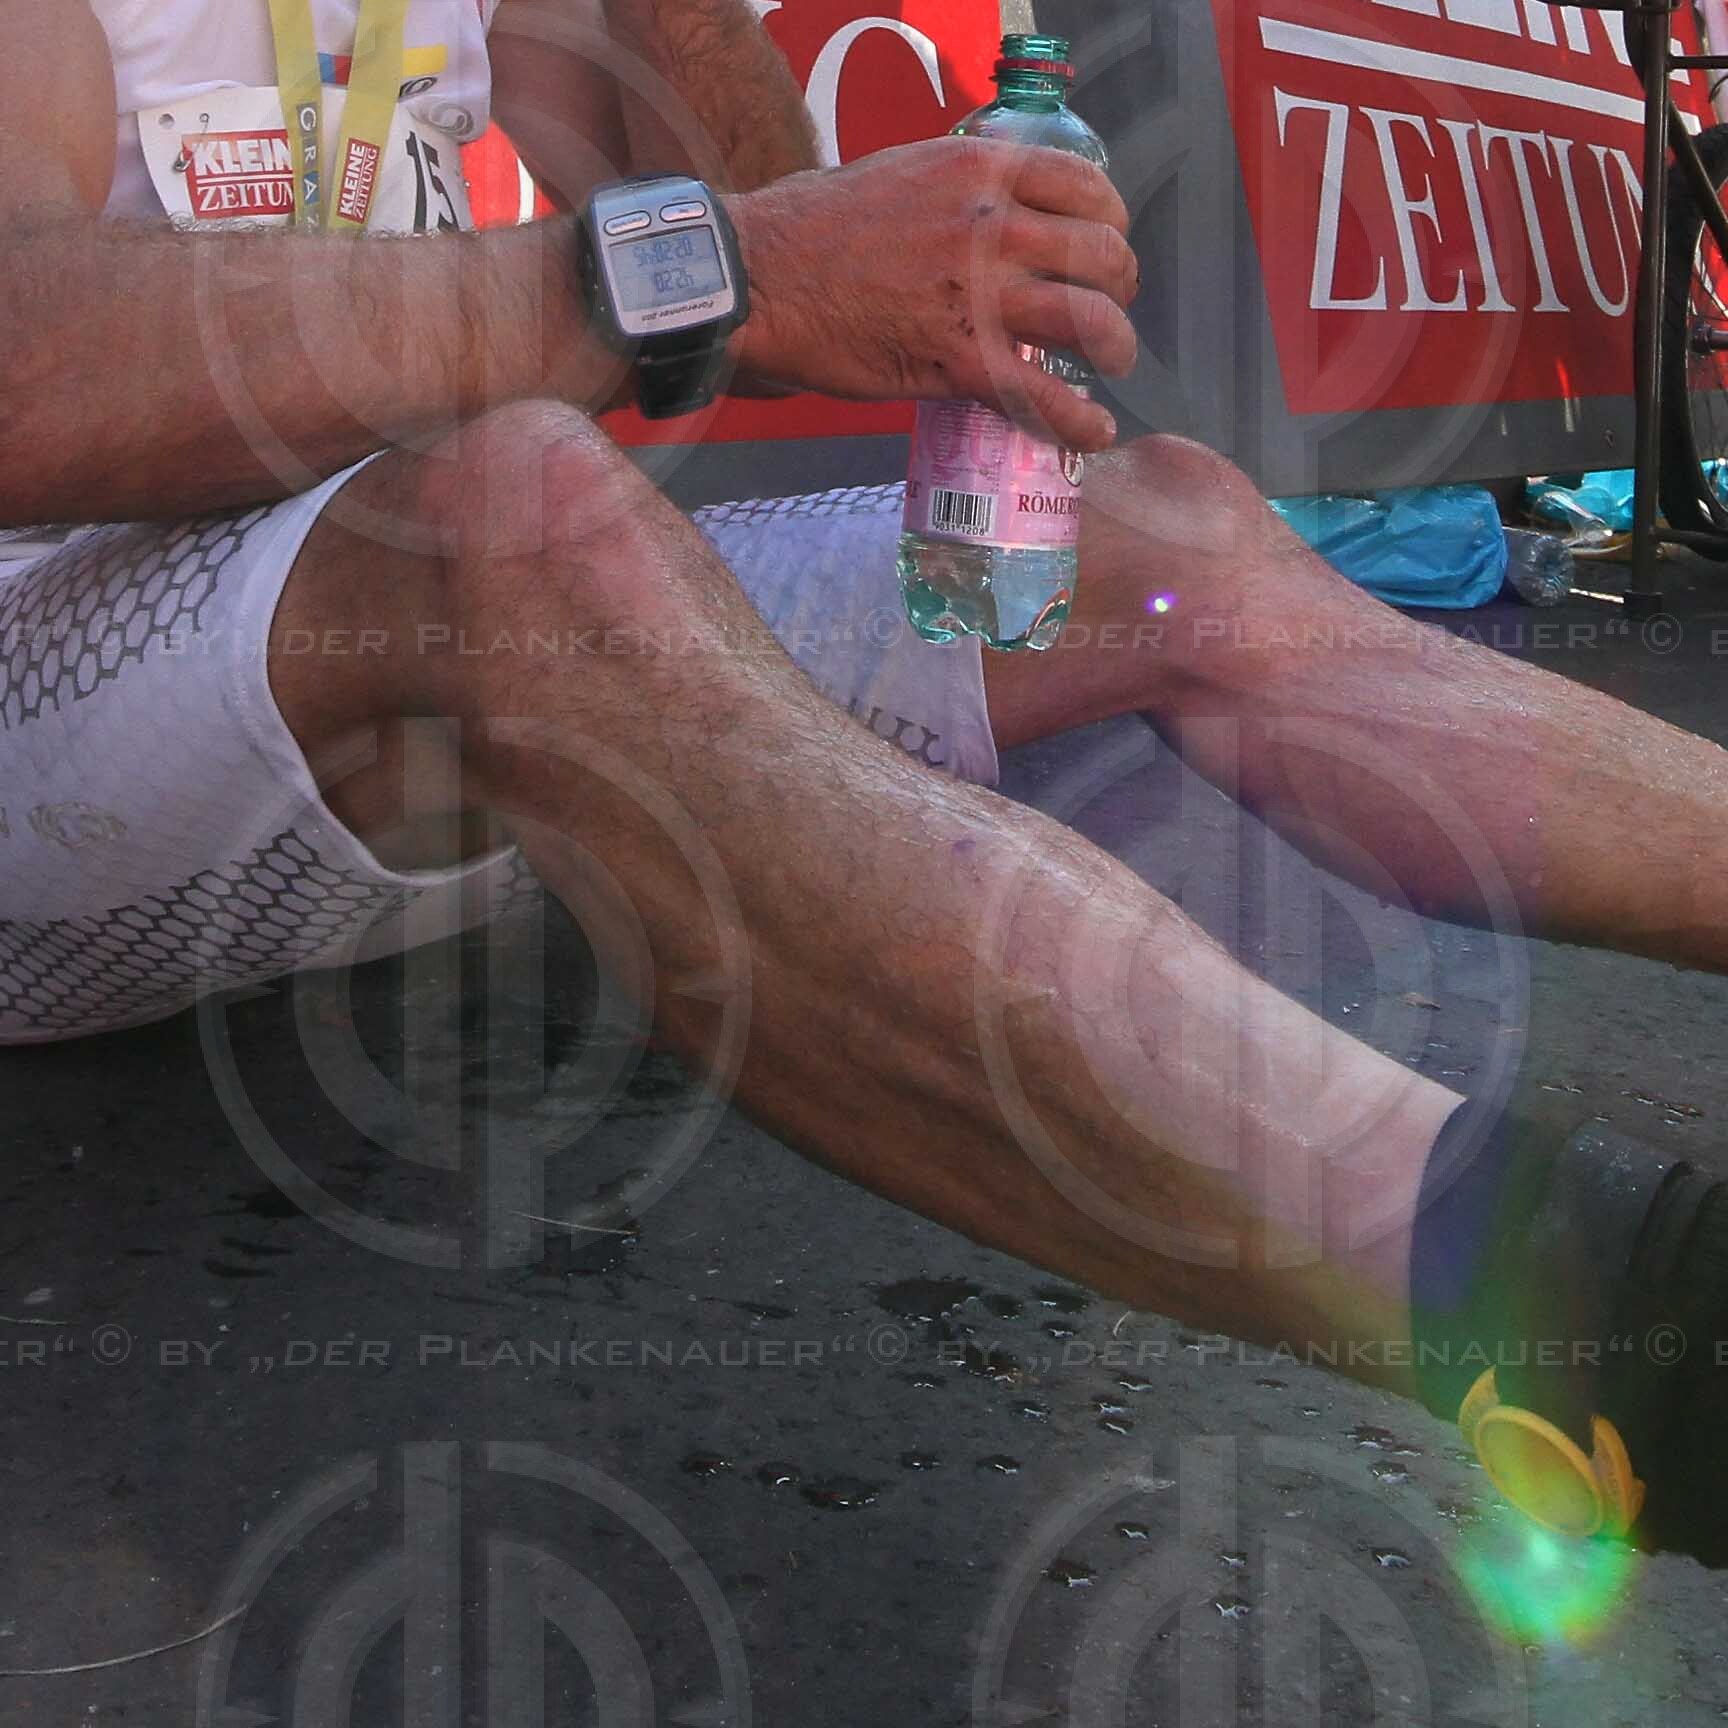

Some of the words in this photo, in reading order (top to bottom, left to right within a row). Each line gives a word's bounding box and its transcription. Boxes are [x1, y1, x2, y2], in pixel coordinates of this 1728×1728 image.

[339, 142, 366, 215] KLEINE
[353, 147, 379, 220] ZEITUNG
[1272, 85, 1644, 318] ZEITU
